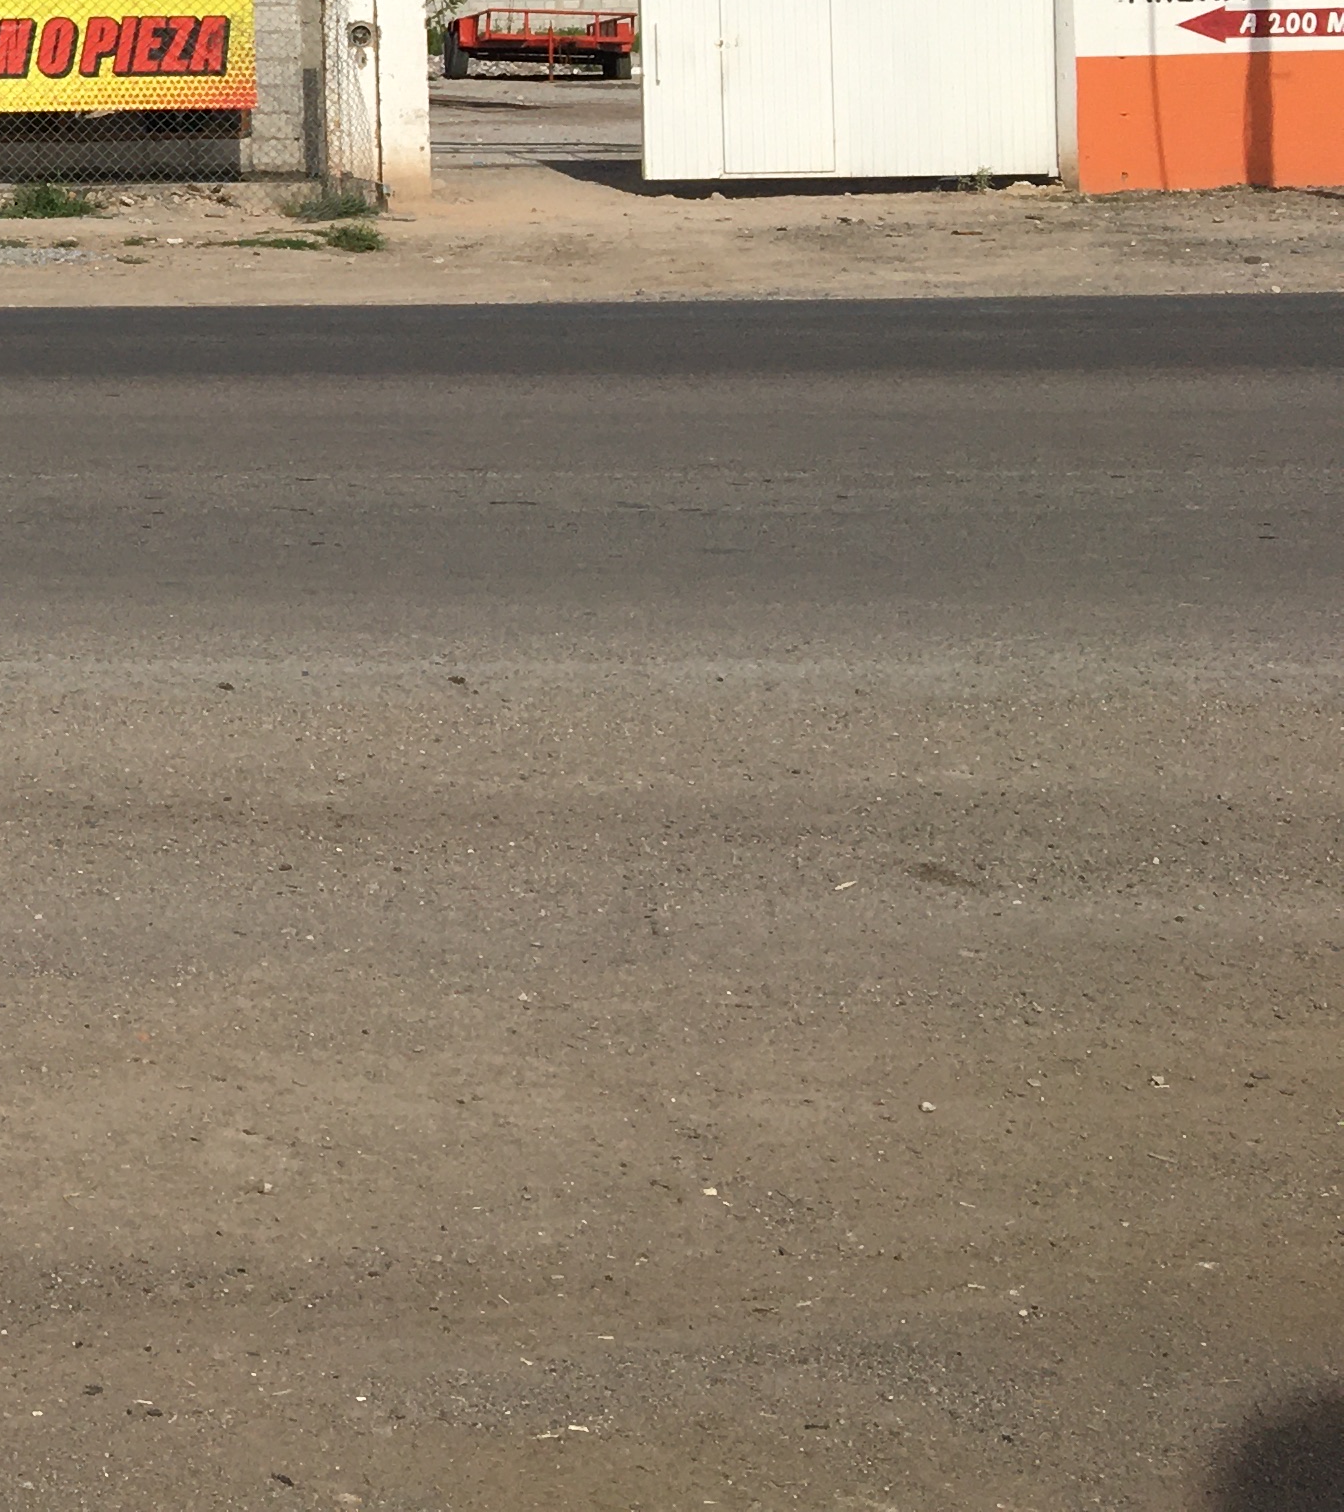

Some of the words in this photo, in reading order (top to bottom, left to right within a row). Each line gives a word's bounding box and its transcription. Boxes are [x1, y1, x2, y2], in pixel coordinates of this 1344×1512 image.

[1239, 12, 1257, 34] A
[1267, 12, 1317, 34] 200
[37, 16, 79, 79] O
[79, 15, 231, 78] PIEZA
